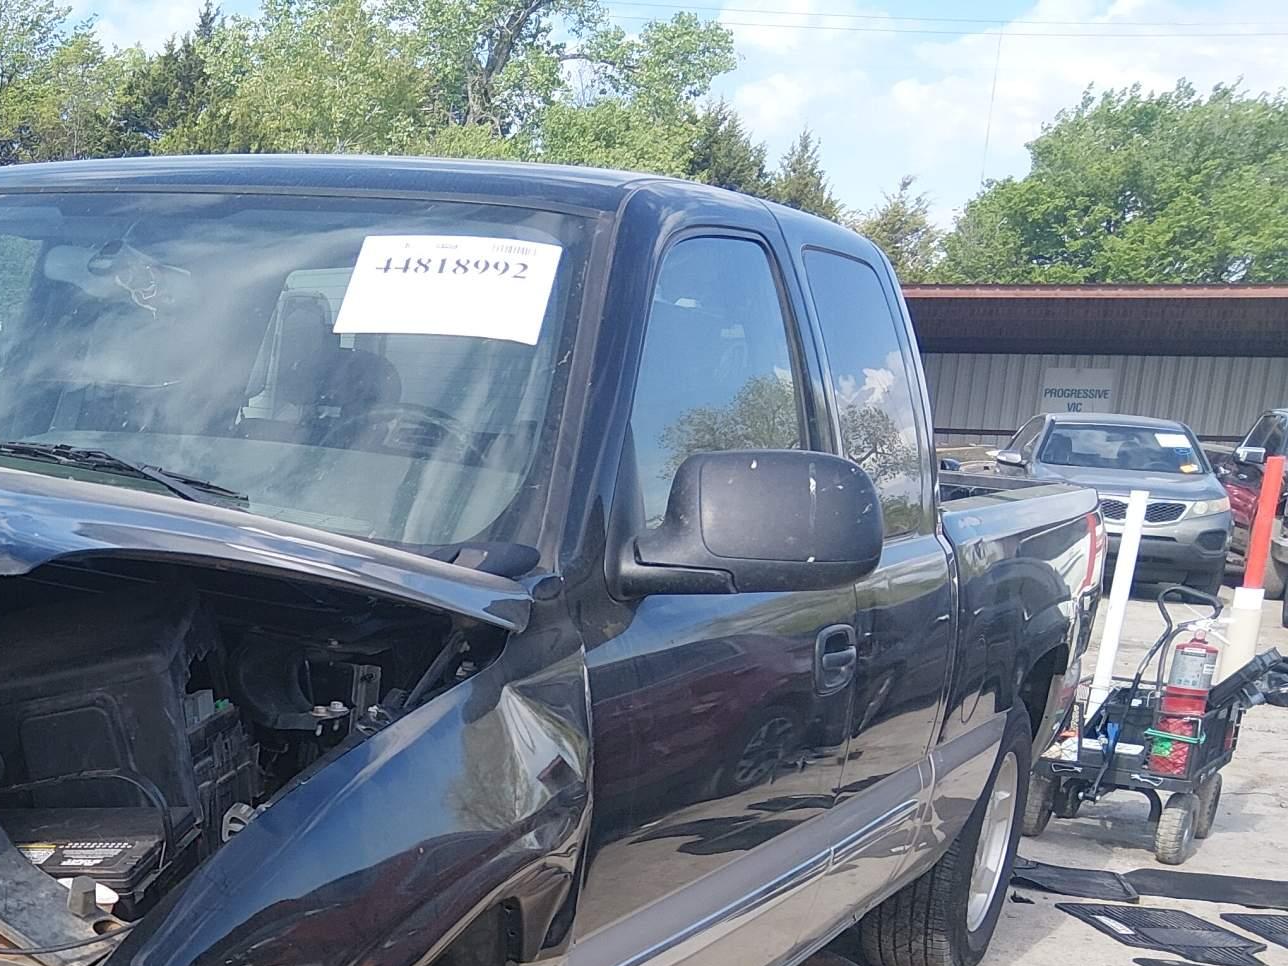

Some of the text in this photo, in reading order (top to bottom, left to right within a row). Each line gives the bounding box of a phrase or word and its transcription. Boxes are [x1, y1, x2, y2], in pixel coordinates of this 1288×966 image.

[376, 257, 530, 279] 44818992
[1044, 388, 1110, 399] PROGRESSIVE
[1067, 402, 1083, 412] VIC
